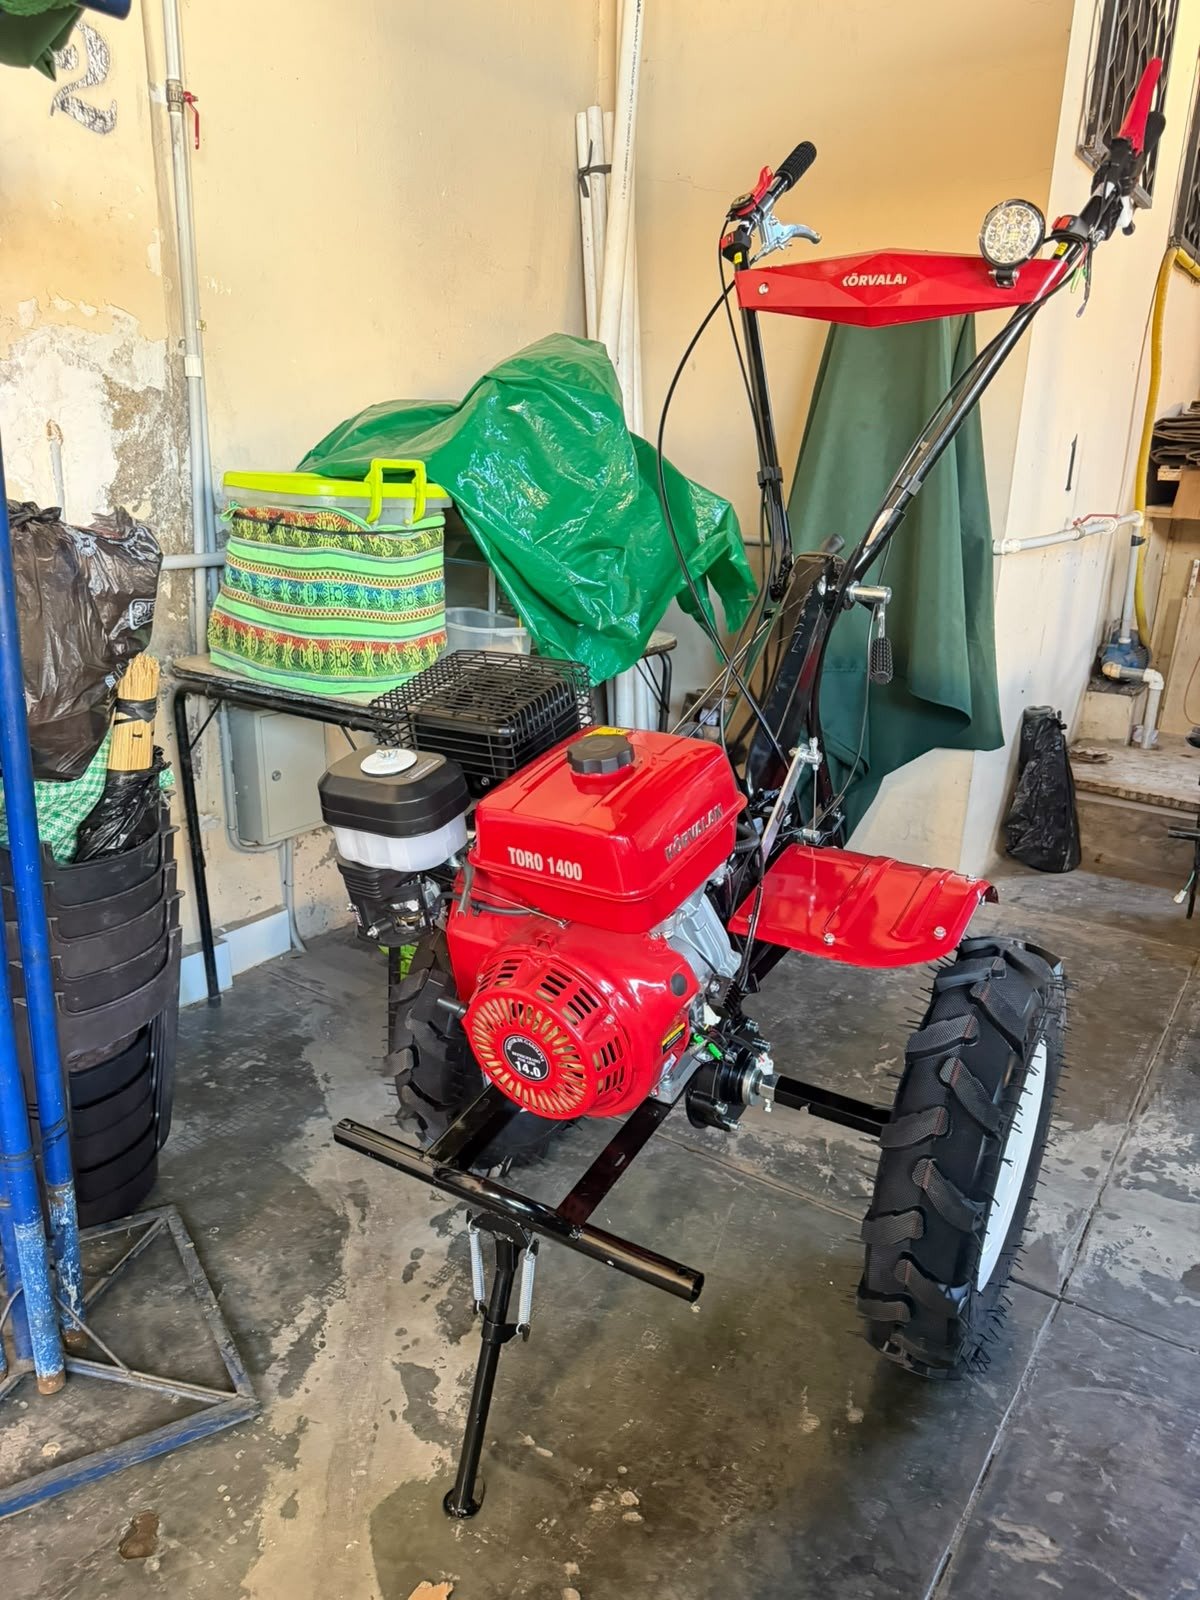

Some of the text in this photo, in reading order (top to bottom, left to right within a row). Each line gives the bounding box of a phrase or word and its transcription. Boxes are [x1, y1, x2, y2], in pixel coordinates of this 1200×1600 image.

[50, 20, 118, 136] 2
[507, 846, 583, 881] TORO 1400
[515, 1061, 541, 1077] 14.0
